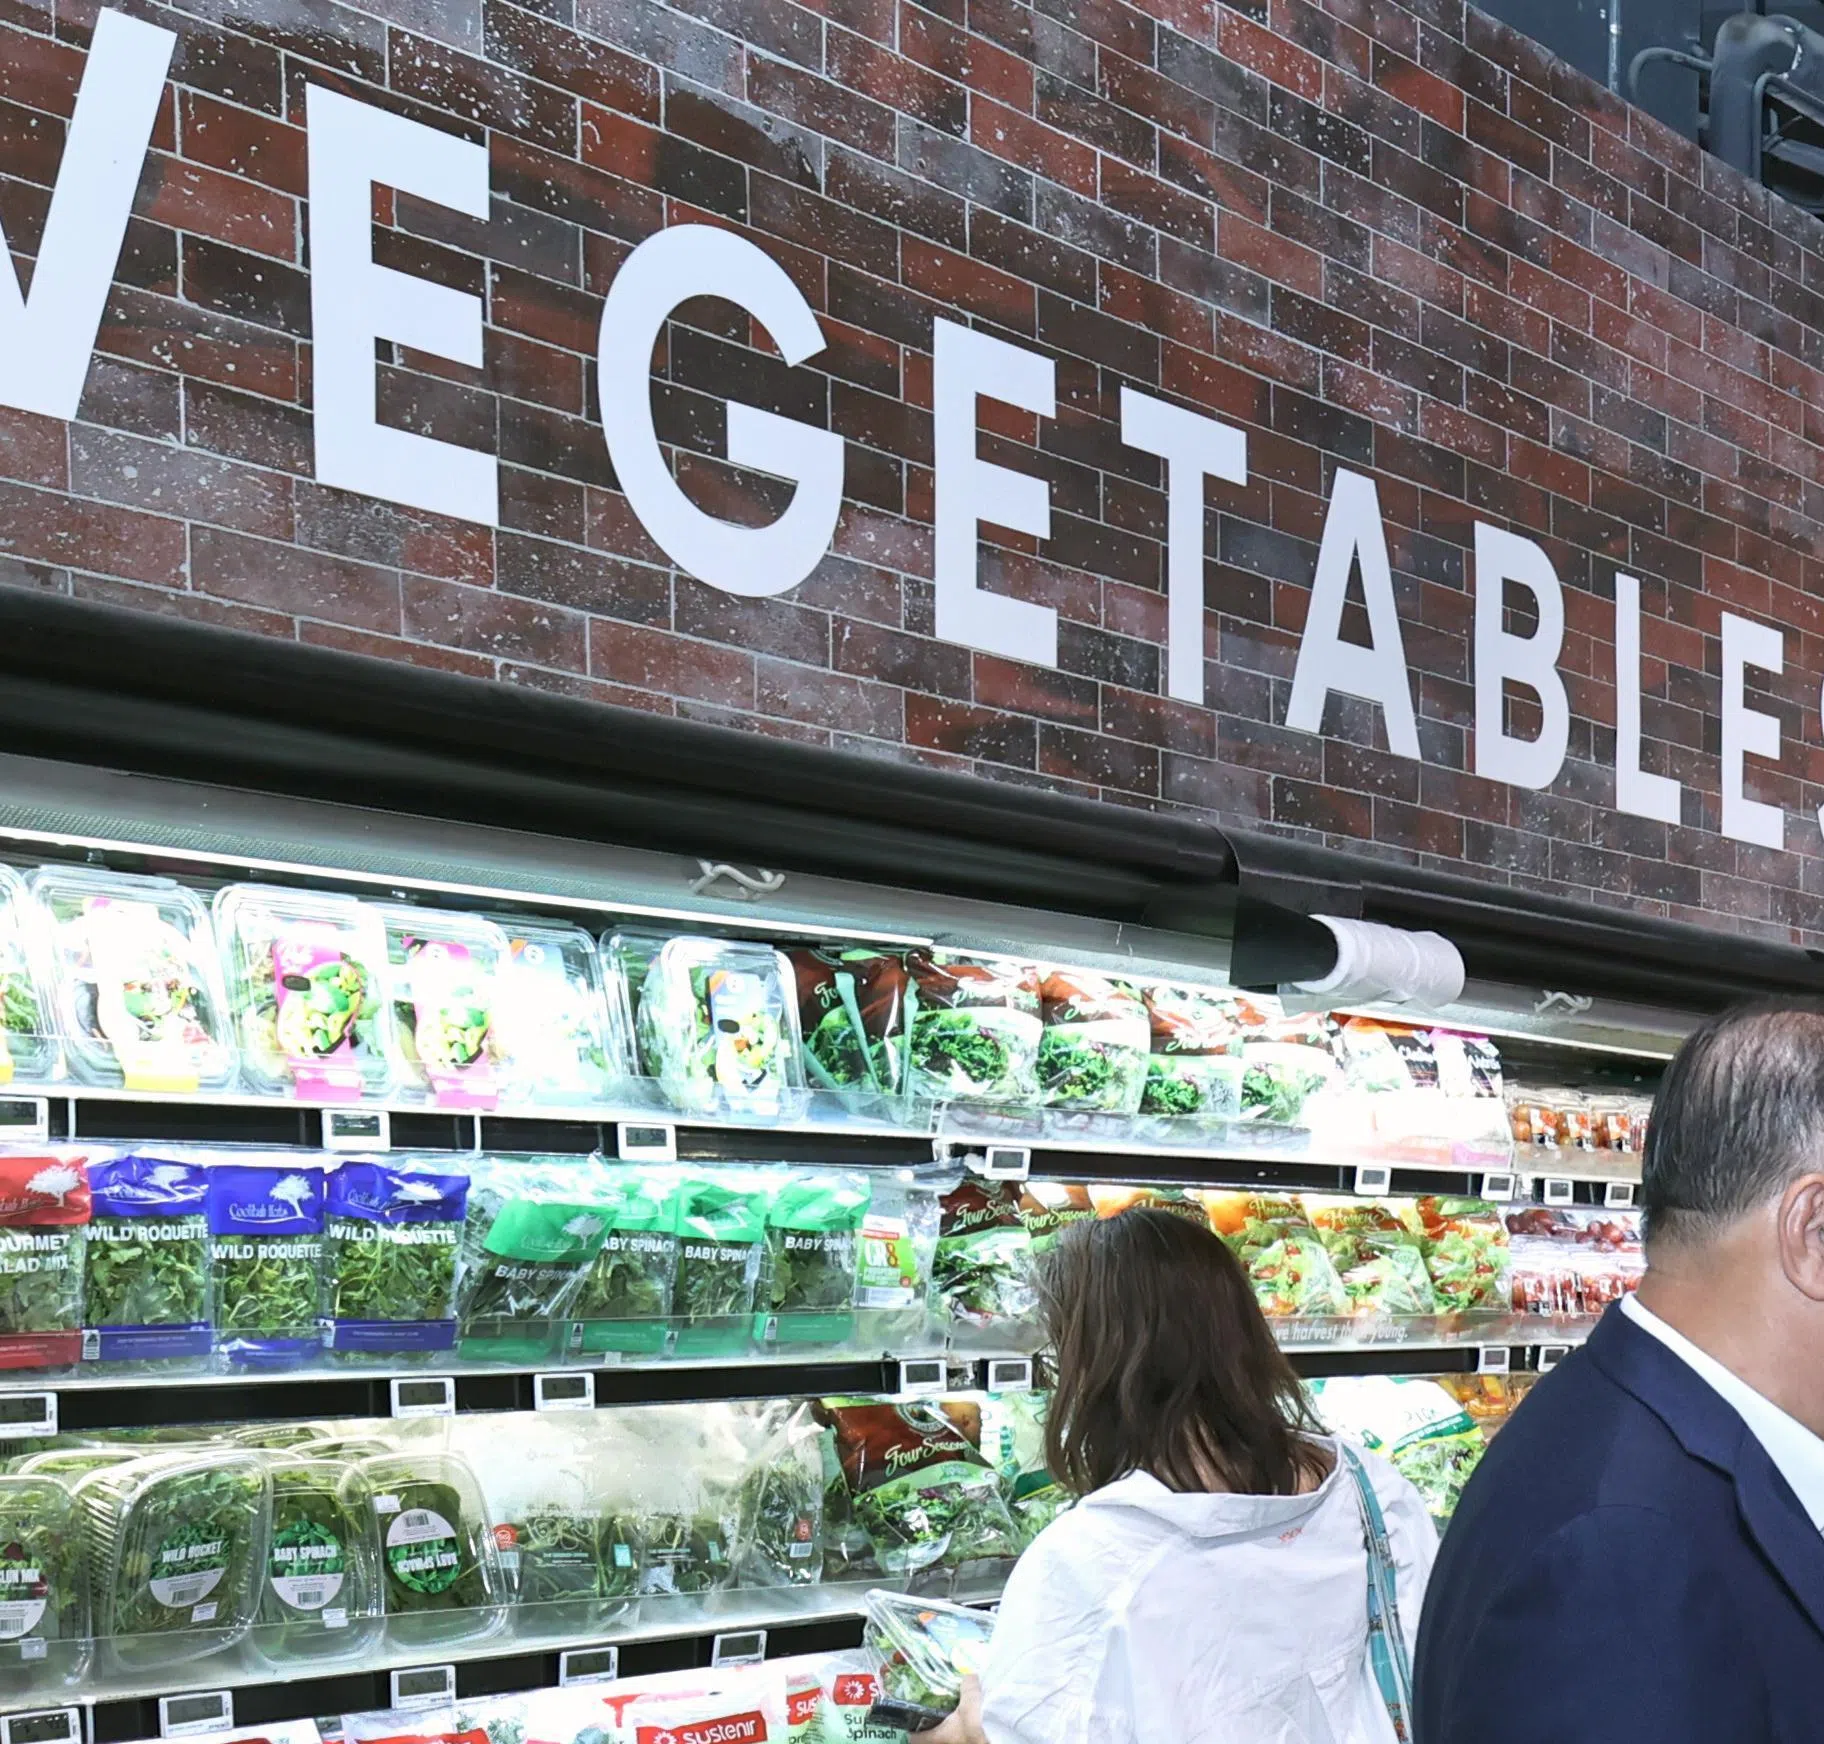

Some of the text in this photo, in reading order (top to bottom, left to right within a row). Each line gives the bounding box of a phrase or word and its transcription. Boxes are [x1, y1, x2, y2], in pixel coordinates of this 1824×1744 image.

[86, 1224, 208, 1241] WILD ROQUETTE
[330, 1224, 457, 1244] WILD ROQUETTE
[211, 1244, 322, 1259] WILD ROQUETTE
[785, 1237, 821, 1250] BABY
[685, 1246, 718, 1260] BABY
[495, 1265, 537, 1278] BABY
[1292, 1321, 1337, 1339] harvest
[884, 1445, 923, 1476] Four
